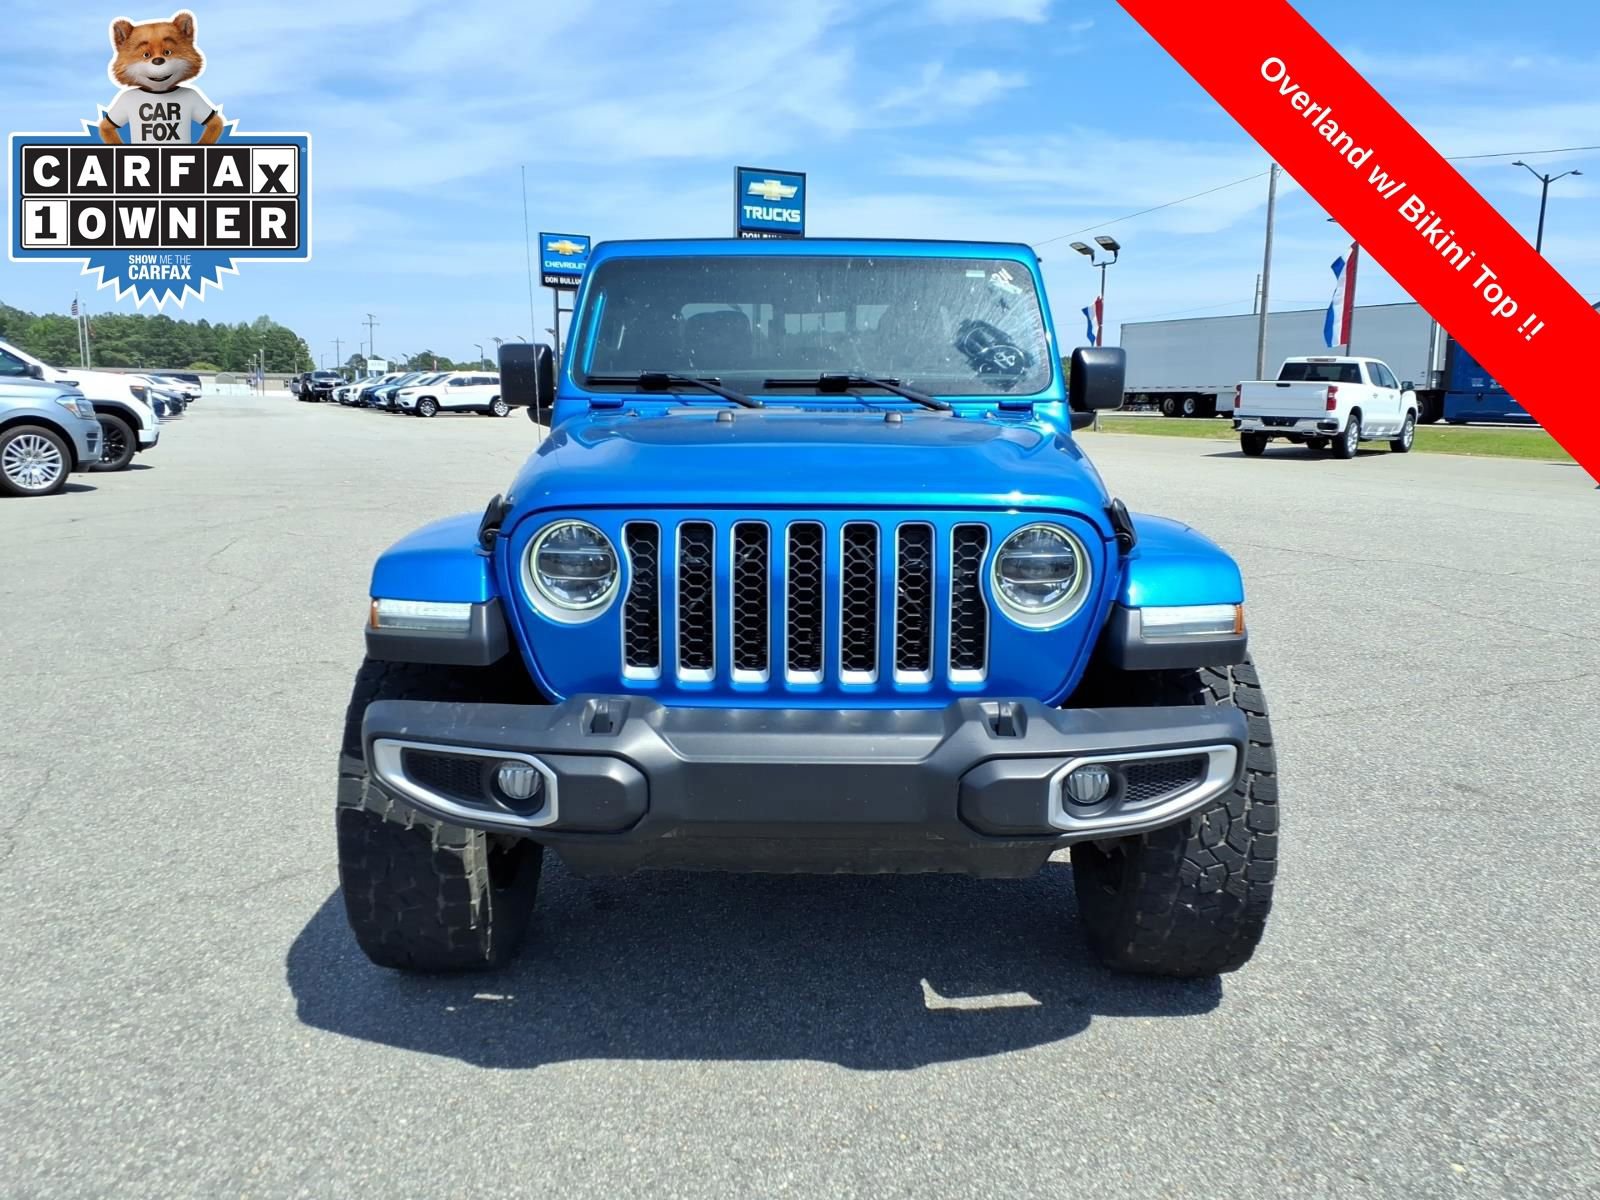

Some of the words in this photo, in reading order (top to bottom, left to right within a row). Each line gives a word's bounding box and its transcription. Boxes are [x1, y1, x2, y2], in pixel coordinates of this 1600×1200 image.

[743, 205, 801, 223] TRUCKS
[544, 260, 587, 270] CHEVROLET
[544, 276, 559, 284] DON
[559, 277, 582, 285] BULLU
